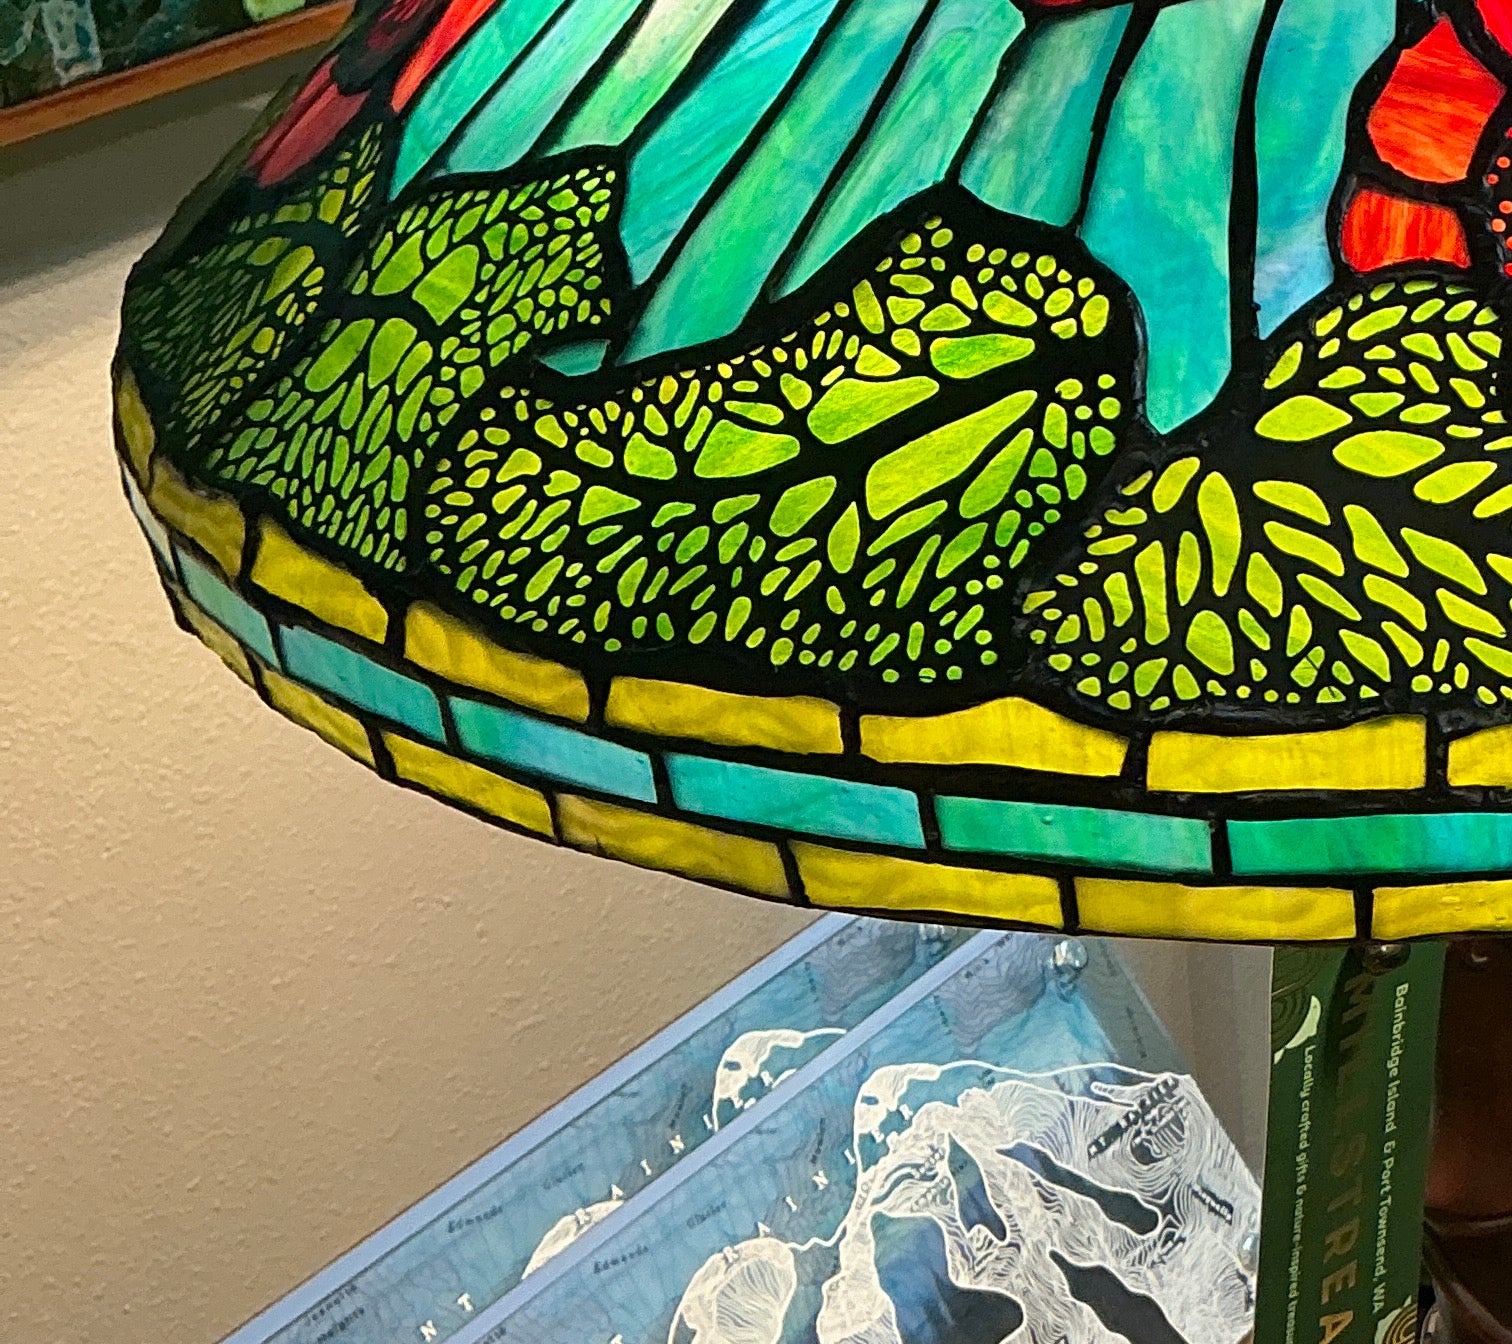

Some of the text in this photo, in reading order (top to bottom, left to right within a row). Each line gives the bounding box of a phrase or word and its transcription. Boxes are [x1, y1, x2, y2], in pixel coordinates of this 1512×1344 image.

[1299, 1044, 1318, 1098] Locally
[1297, 1099, 1313, 1150] crafted
[1371, 982, 1410, 1315] Bainbridge Island & Port Townsend, WA
[1294, 1151, 1309, 1183] gifts
[1294, 1184, 1308, 1196] &
[1286, 1197, 1305, 1299] nature-inspired
